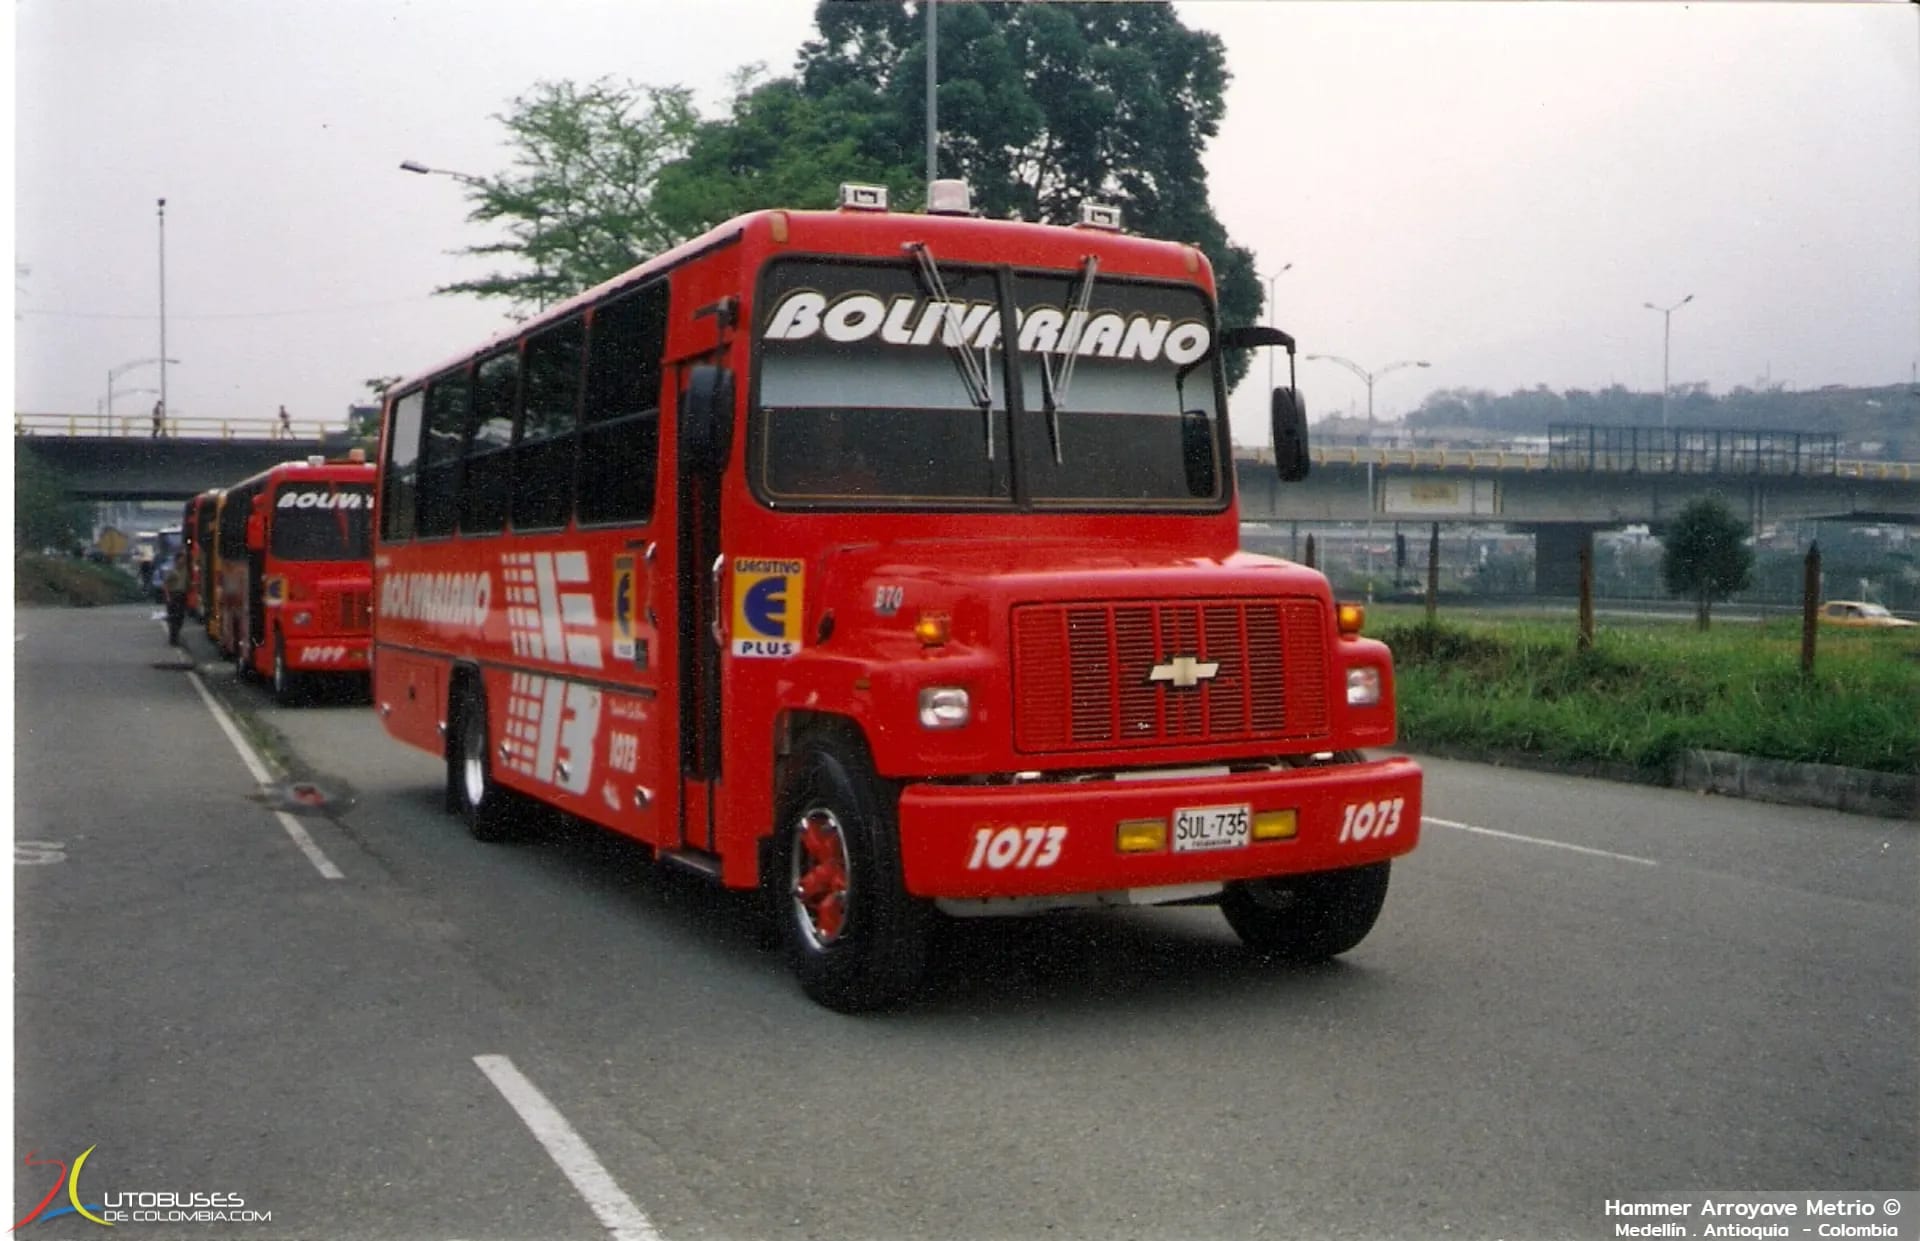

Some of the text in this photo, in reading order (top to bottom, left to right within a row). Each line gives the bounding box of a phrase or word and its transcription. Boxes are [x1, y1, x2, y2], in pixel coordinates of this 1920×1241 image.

[764, 291, 1210, 365] BOLIVARIANO
[741, 641, 793, 655] PLUS
[1339, 797, 1404, 843] 1073
[968, 826, 1067, 869] 1073
